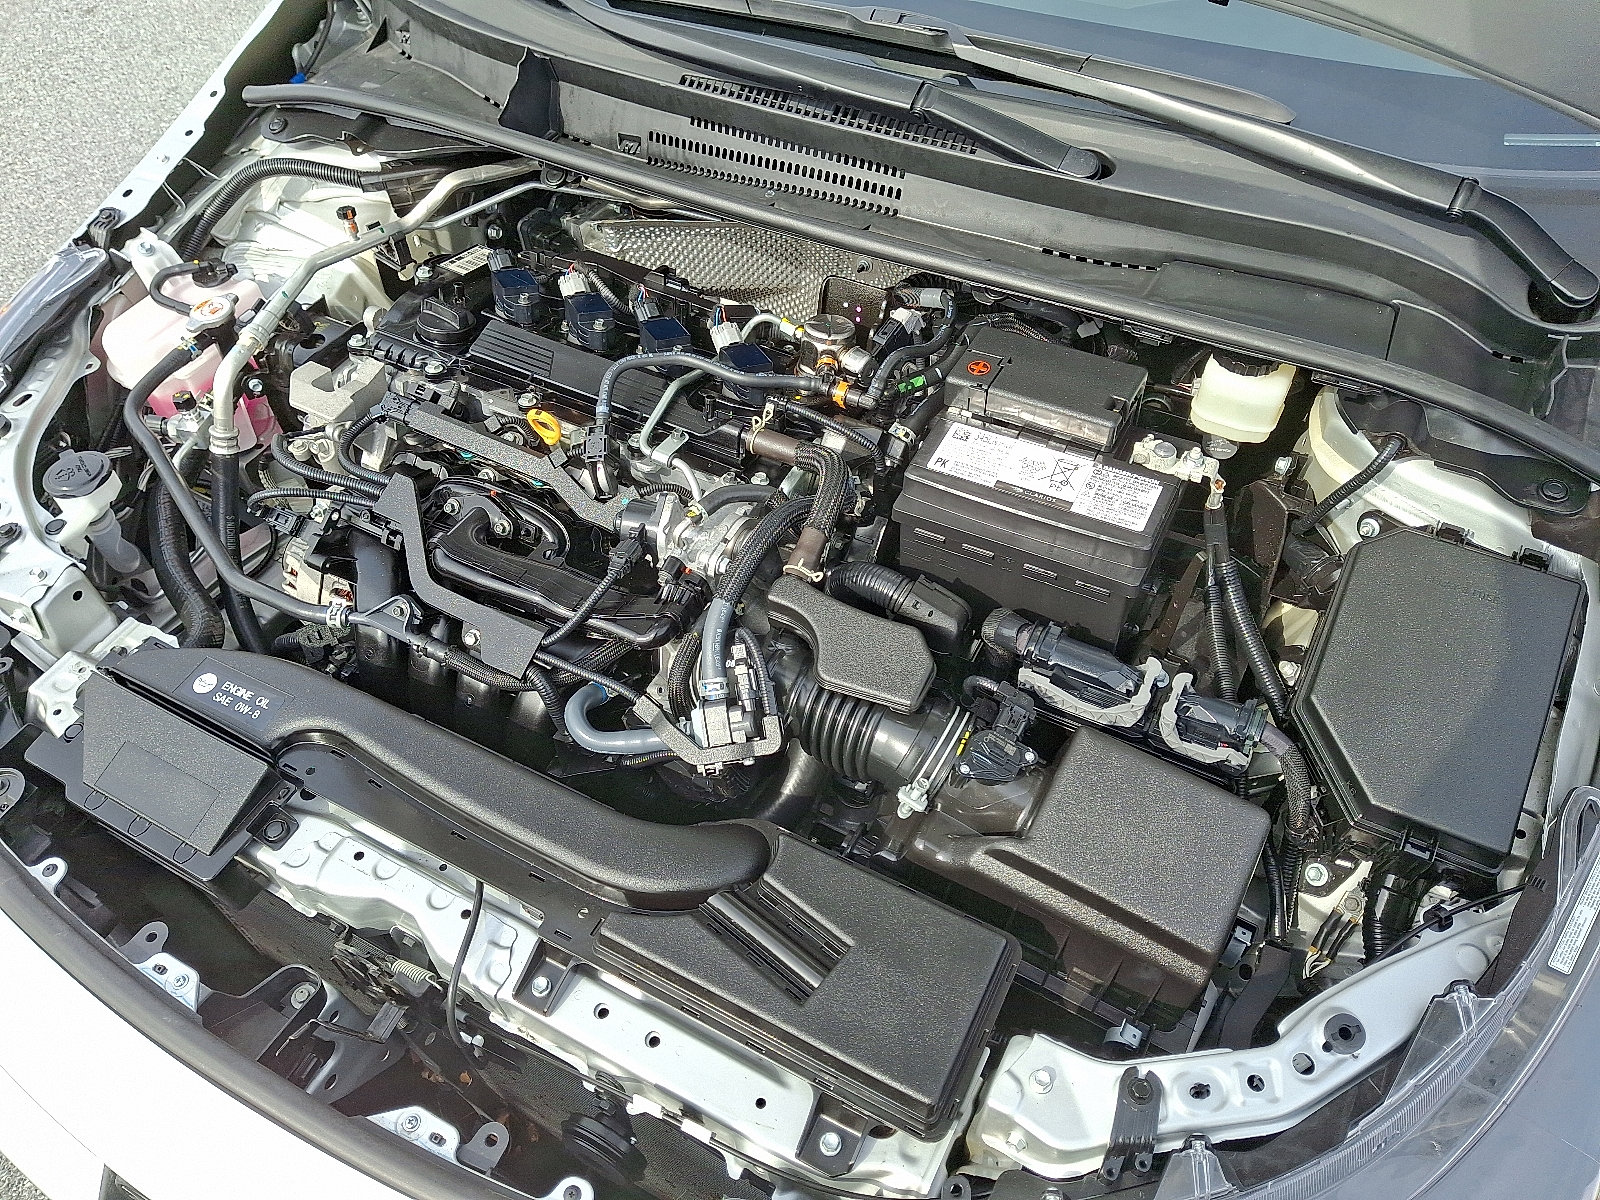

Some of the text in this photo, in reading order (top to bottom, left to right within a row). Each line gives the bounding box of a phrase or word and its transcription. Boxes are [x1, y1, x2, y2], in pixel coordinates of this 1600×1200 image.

[934, 457, 949, 468] PK
[213, 692, 261, 719] SAE 0W-8
[221, 681, 270, 709] ENGINE OIL
